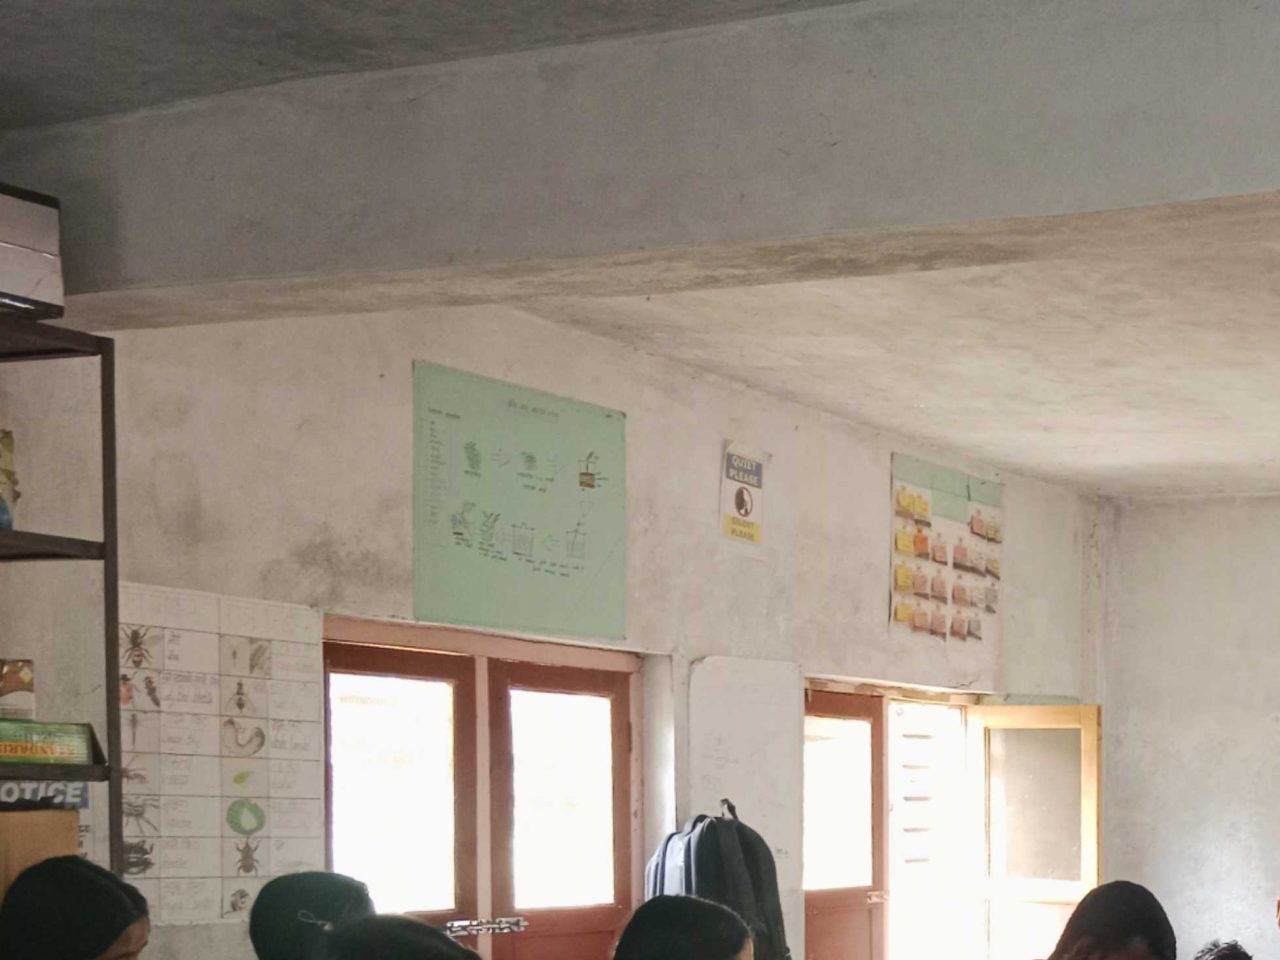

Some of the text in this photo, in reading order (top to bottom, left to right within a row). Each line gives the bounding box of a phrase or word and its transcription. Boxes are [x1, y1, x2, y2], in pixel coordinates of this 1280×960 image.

[732, 456, 757, 470] QUIET
[729, 468, 759, 485] PLEASE
[0, 781, 84, 805] OTICE
